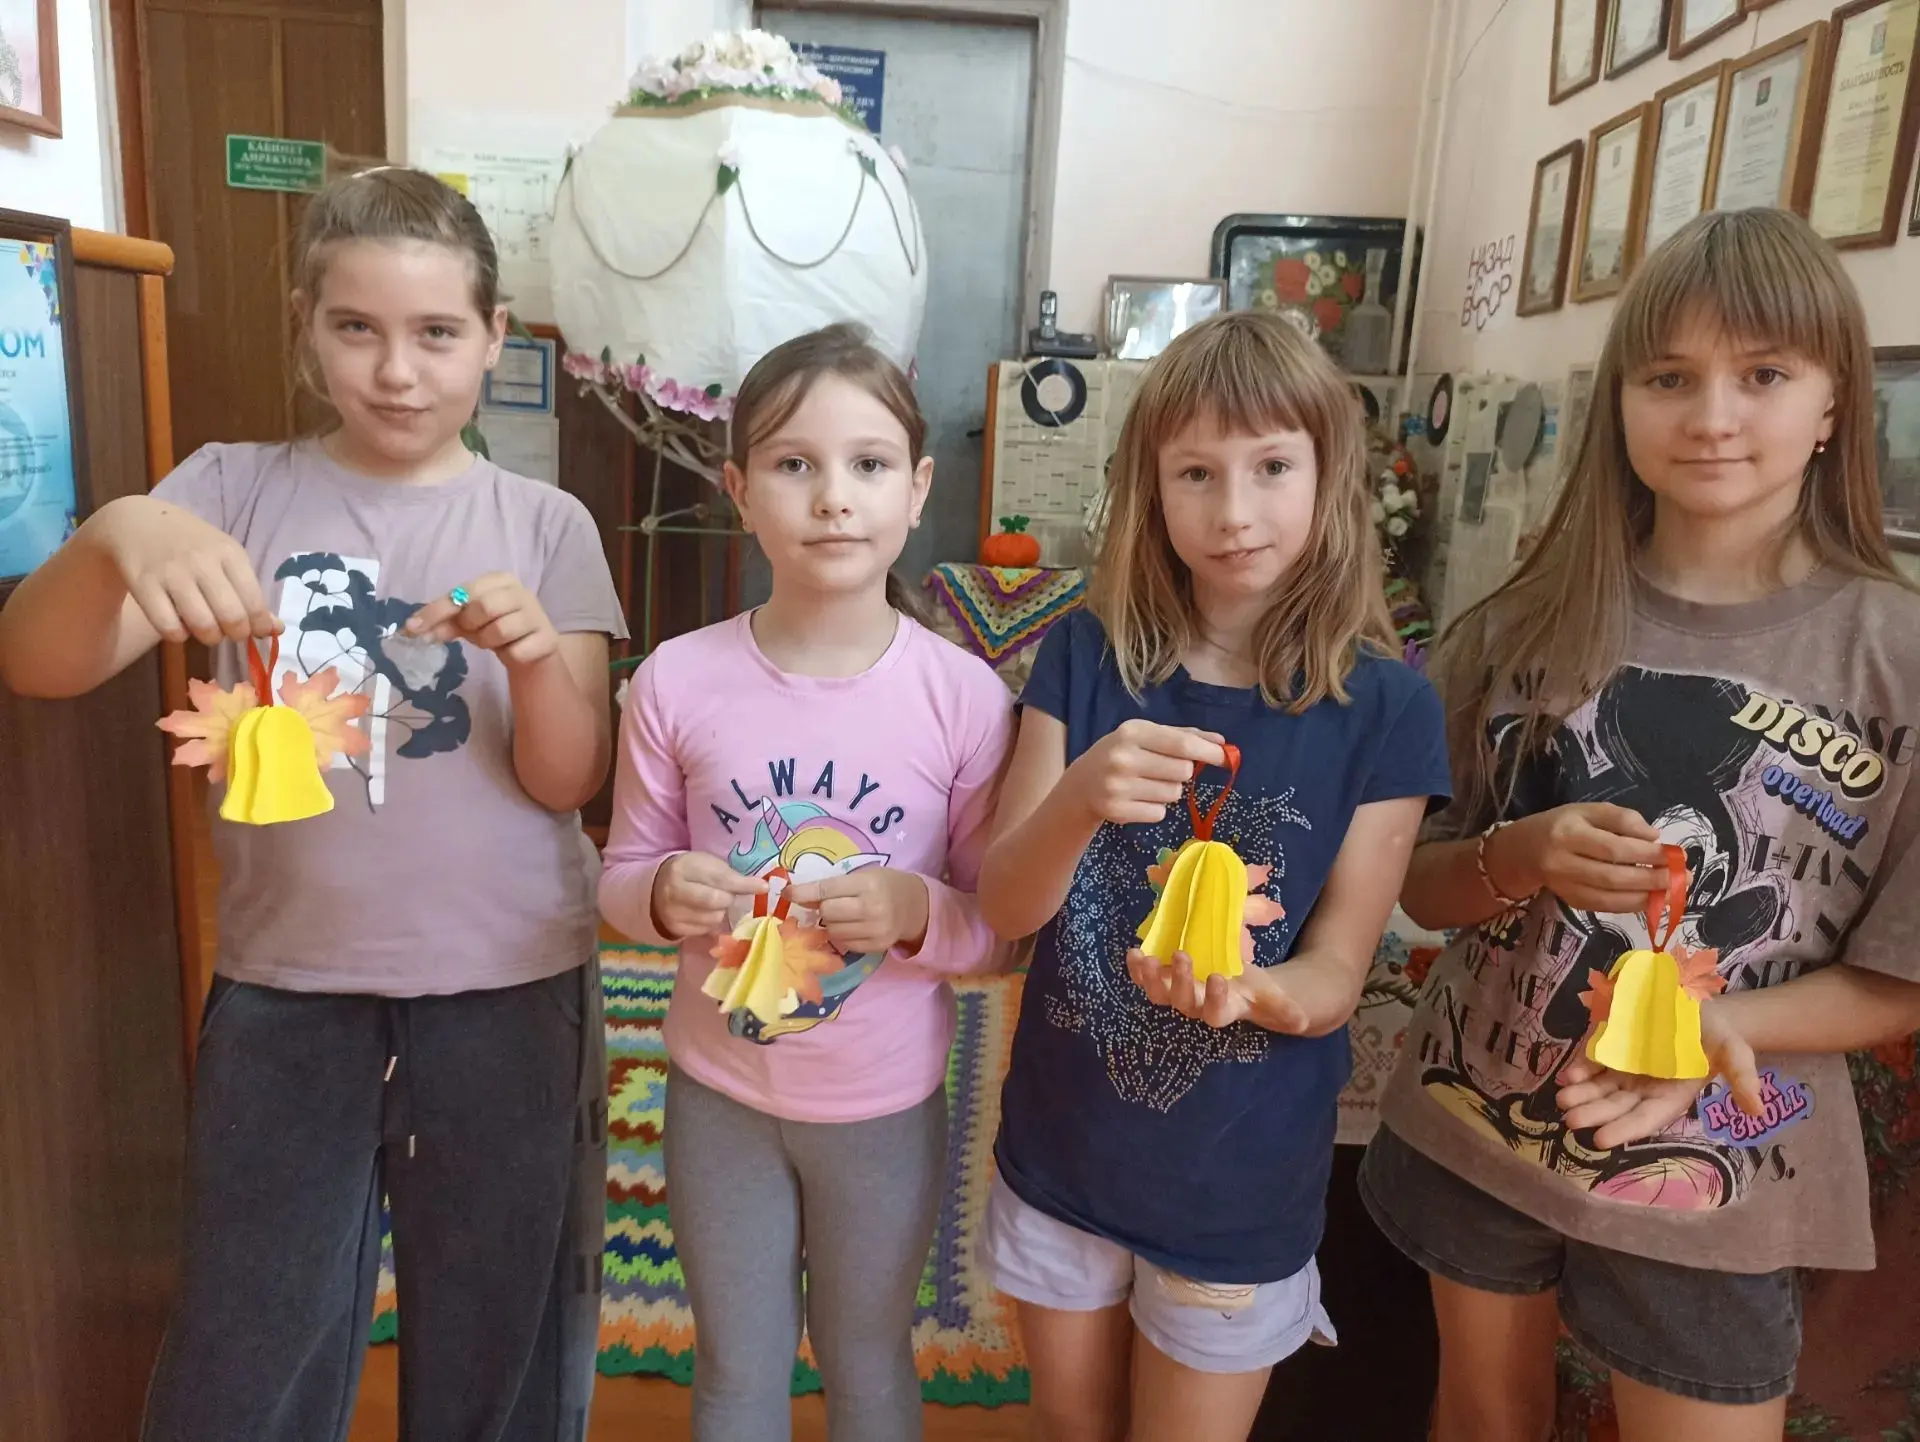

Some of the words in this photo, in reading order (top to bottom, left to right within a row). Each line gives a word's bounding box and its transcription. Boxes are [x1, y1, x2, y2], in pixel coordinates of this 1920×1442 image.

[240, 151, 312, 168] ДИРЕКТОРА
[247, 140, 303, 155] КАБИНЕТ
[1730, 691, 1884, 798] DISCO
[710, 757, 905, 835] ALWAYS
[1760, 764, 1868, 849] overload
